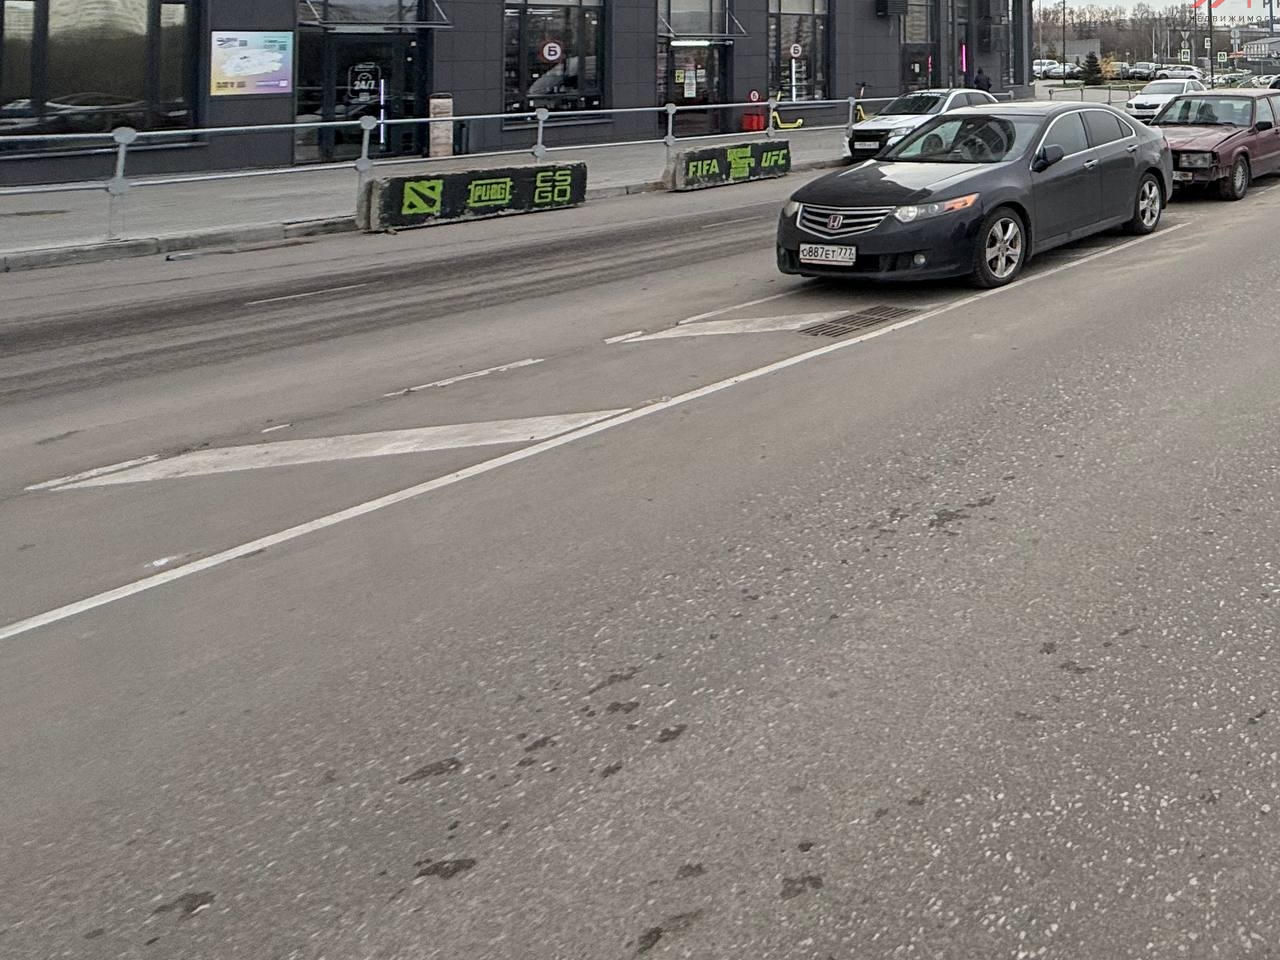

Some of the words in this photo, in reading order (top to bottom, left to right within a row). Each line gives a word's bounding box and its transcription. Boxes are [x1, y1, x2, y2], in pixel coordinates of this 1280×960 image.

[760, 149, 788, 167] UFC
[687, 158, 720, 178] FIFA
[533, 185, 571, 203] GO
